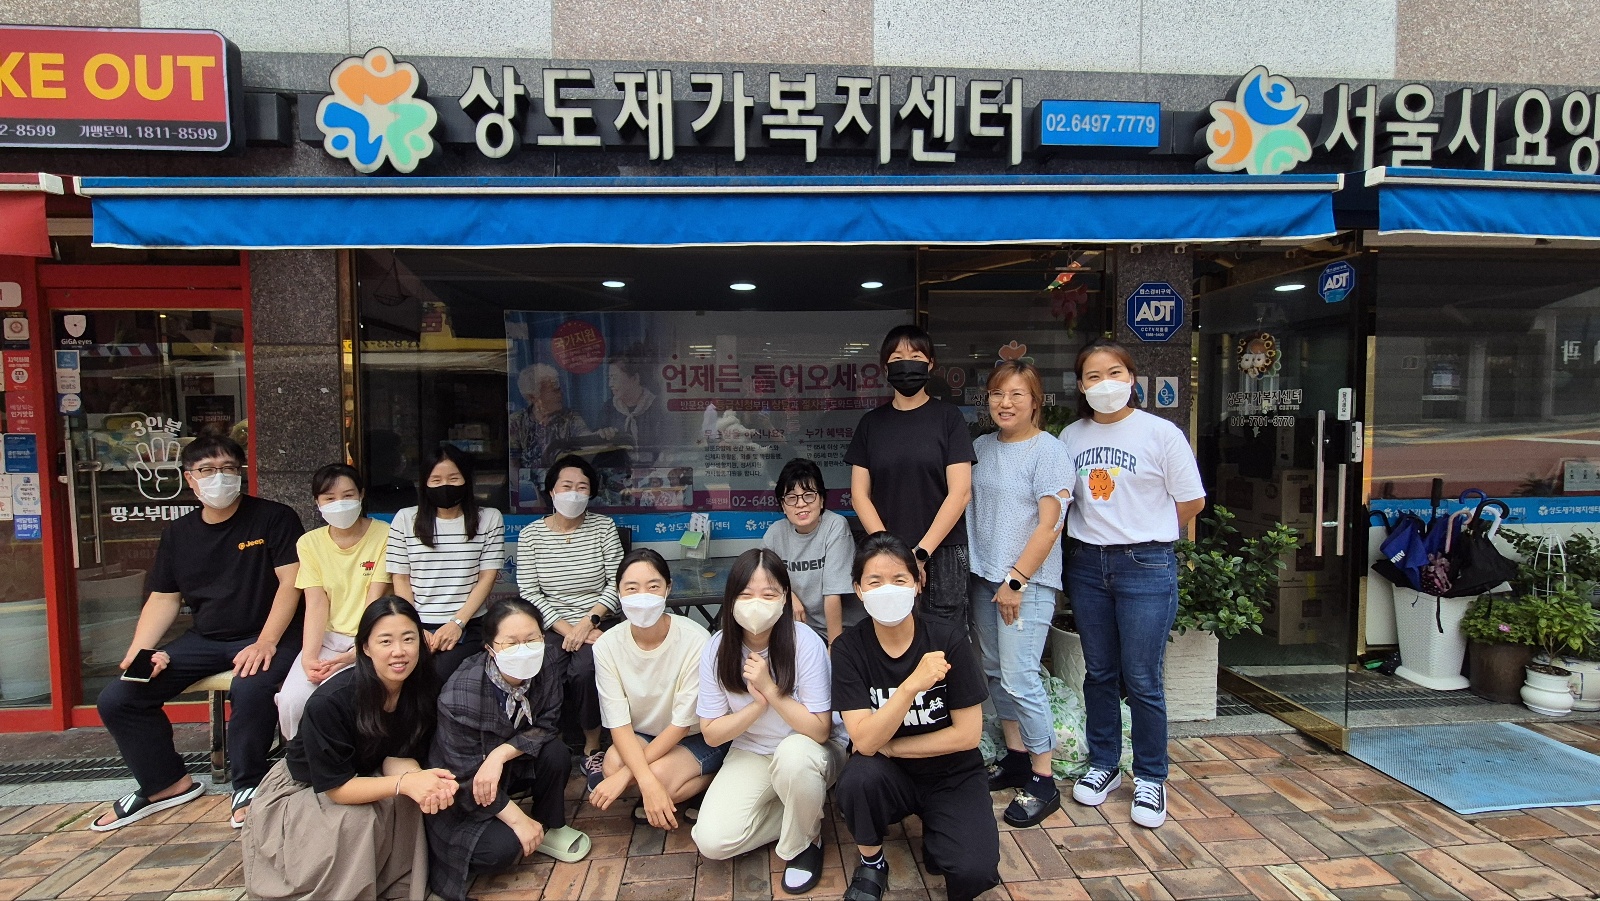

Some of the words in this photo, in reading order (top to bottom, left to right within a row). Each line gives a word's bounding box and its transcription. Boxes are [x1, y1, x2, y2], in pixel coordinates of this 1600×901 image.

[83, 53, 216, 102] OUT
[458, 65, 1023, 166] 상도재가복지센터
[1045, 112, 1157, 134] 02.6497.7779
[136, 127, 218, 141] 1811-8599
[1323, 271, 1350, 291] ADT
[1135, 300, 1175, 322] ADT
[552, 328, 598, 350] 국가지원
[60, 382, 76, 390] eats
[661, 363, 743, 393] 언제든
[805, 428, 824, 439] 누가
[110, 505, 200, 522] 땅스부대
[245, 538, 265, 548] Jeep
